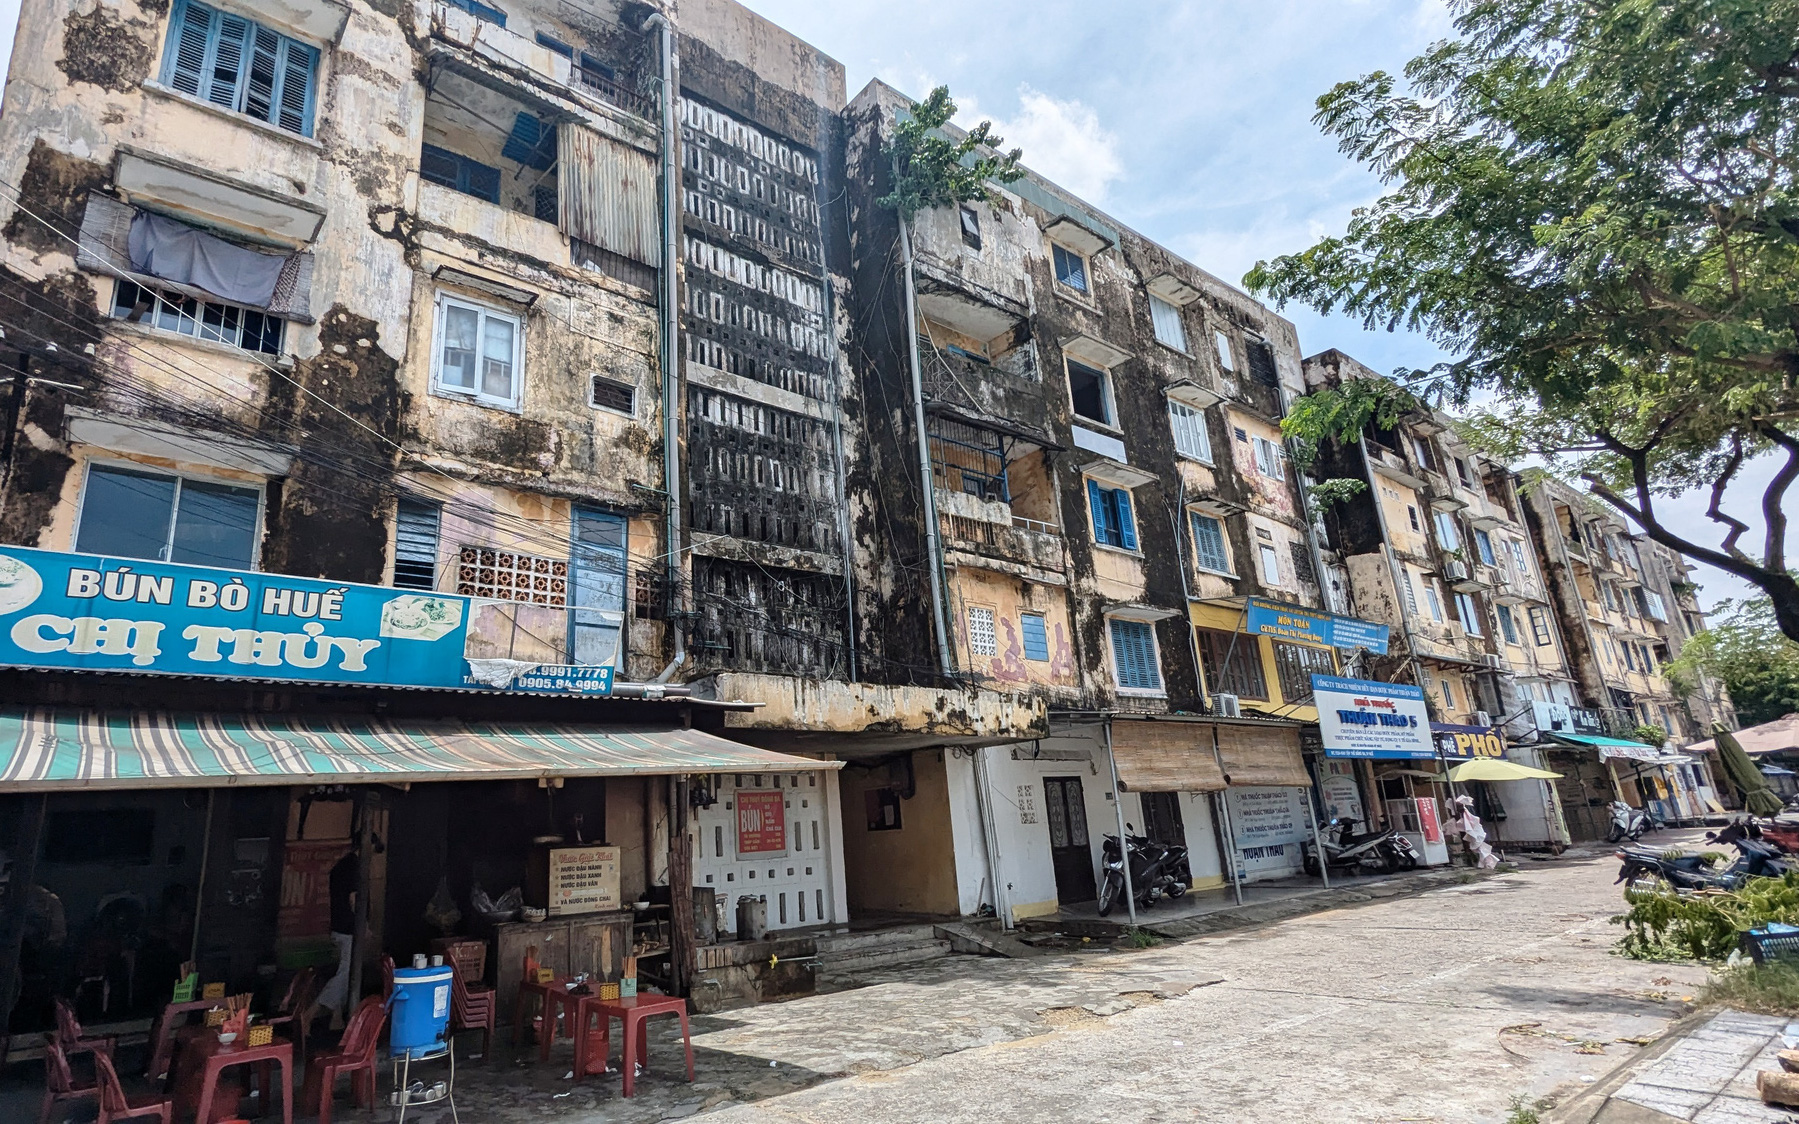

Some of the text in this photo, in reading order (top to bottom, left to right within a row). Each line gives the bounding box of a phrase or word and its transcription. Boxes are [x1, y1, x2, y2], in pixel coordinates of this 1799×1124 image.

[65, 566, 350, 621] BÚN BÒ HUẾ
[1277, 614, 1310, 629] MÔN TOÁN
[11, 614, 381, 671] CHỊ THỦY
[525, 666, 608, 679] .9991.7778
[1370, 698, 1395, 708] THUỐC
[1336, 707, 1418, 728] THUẬN THẢO 5
[741, 804, 760, 832] BÚN
[576, 864, 586, 872] ĐẬU
[576, 872, 586, 880] ĐẬU
[576, 880, 586, 888] ĐẬU
